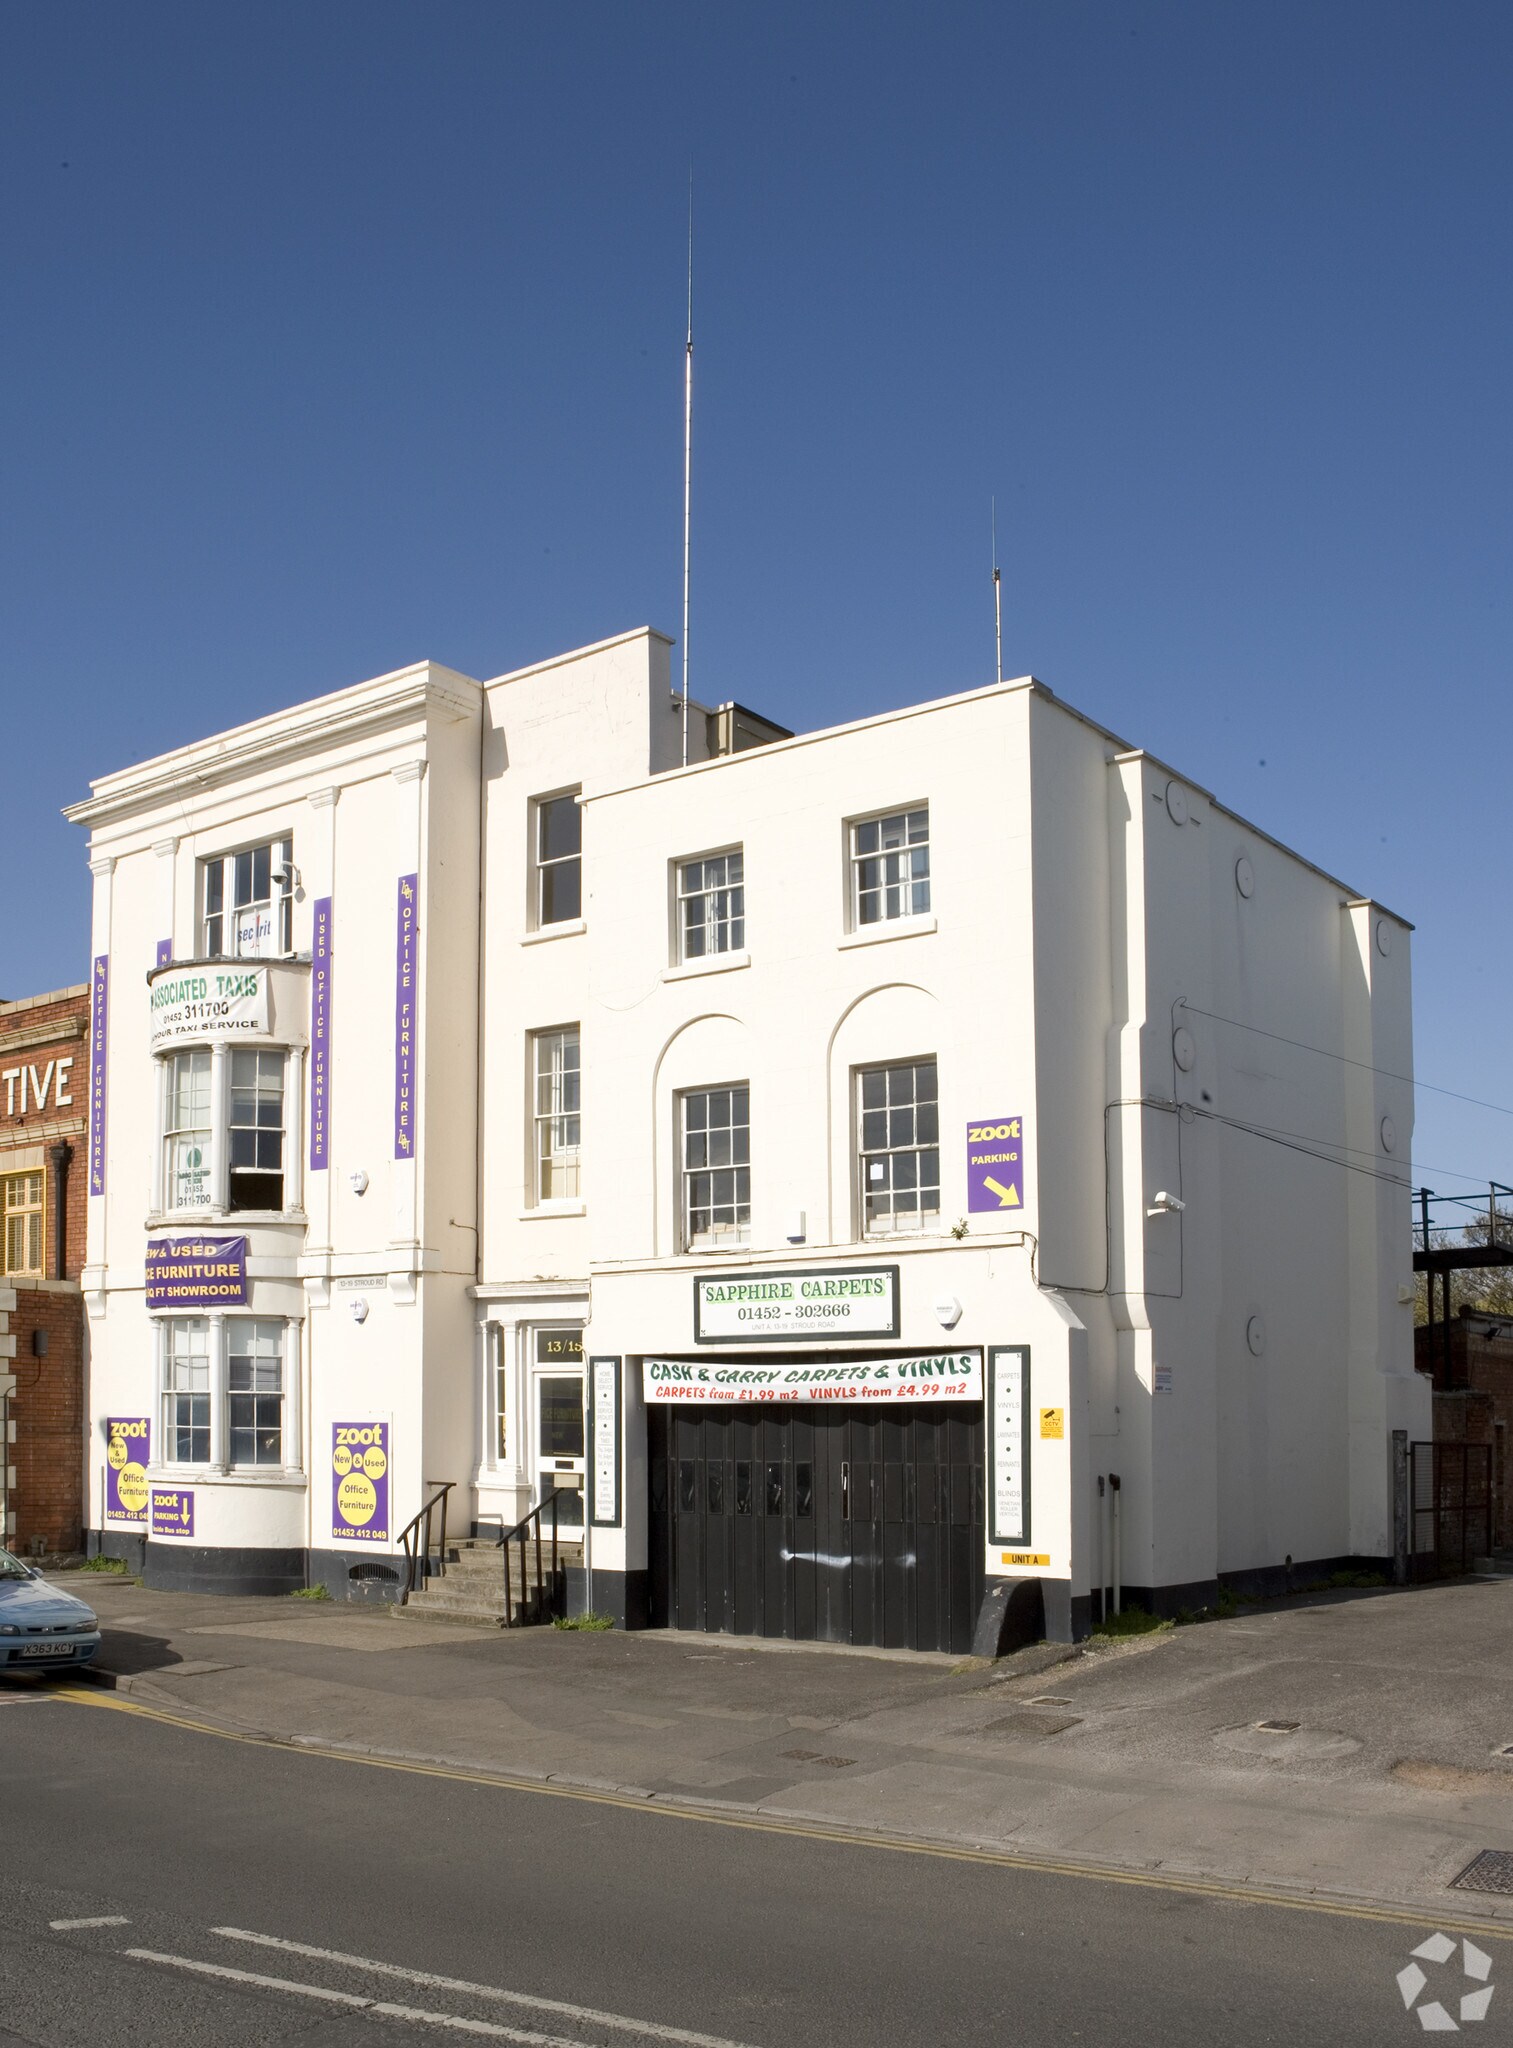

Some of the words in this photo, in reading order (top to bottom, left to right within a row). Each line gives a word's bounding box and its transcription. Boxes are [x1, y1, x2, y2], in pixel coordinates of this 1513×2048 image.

[318, 913, 326, 958] USED
[402, 907, 412, 988] OFFICE
[154, 978, 207, 1009] ASSOCIATED
[216, 974, 258, 997] TAXIS
[184, 1001, 229, 1020] 311700
[317, 971, 325, 1038] OFFICE
[96, 983, 104, 1051] OFFICE
[175, 1024, 198, 1034] TAXI
[201, 1020, 259, 1031] SERVICE
[401, 1003, 410, 1126] FURNITURE
[2, 1056, 74, 1116] TIVE
[968, 1119, 1020, 1143] zoot
[971, 1152, 1018, 1165] PARKING
[171, 1245, 217, 1257] USED
[156, 1263, 240, 1280] FURNITURE
[155, 1287, 166, 1298] FT
[167, 1284, 242, 1298] SHOWROOM
[706, 1282, 793, 1302] SAPPHIRE
[801, 1277, 884, 1298] CARPETS
[737, 1306, 781, 1321] 01452
[795, 1303, 851, 1319] 302666
[790, 1320, 816, 1330] STROUD
[817, 1319, 836, 1329] ROAD
[650, 1362, 694, 1381] CASH
[697, 1367, 711, 1382] &
[783, 1366, 871, 1384] CARPETS
[874, 1364, 890, 1380] &
[897, 1355, 972, 1378] VINYLS
[997, 1372, 1021, 1381] CARPETS
[655, 1385, 706, 1400] CARPETS
[708, 1387, 735, 1400] from
[737, 1388, 776, 1401] £1.99
[778, 1388, 800, 1400] m2
[809, 1386, 857, 1400] VINYLS
[860, 1384, 892, 1398] from
[895, 1382, 941, 1398] £4.99
[943, 1381, 968, 1396] m2
[997, 1402, 1021, 1410] VINYLS
[110, 1418, 148, 1438] zoot
[336, 1423, 383, 1446] zoot
[334, 1454, 350, 1464] New
[364, 1459, 385, 1468] Used
[123, 1473, 145, 1484] Office
[344, 1484, 369, 1495] Office
[997, 1489, 1021, 1497] BLINDS
[153, 1493, 179, 1508] zoot
[339, 1499, 374, 1511] Furniture
[126, 1510, 139, 1520] 412
[153, 1511, 179, 1521] PARKING
[175, 1527, 190, 1536] stop
[333, 1527, 355, 1538] 01452
[356, 1529, 371, 1539] 412
[372, 1529, 387, 1540] 049
[1011, 1554, 1031, 1564] UNIT
[1033, 1555, 1039, 1565] A
[25, 1643, 52, 1655] X363
[53, 1641, 75, 1653] KCY
